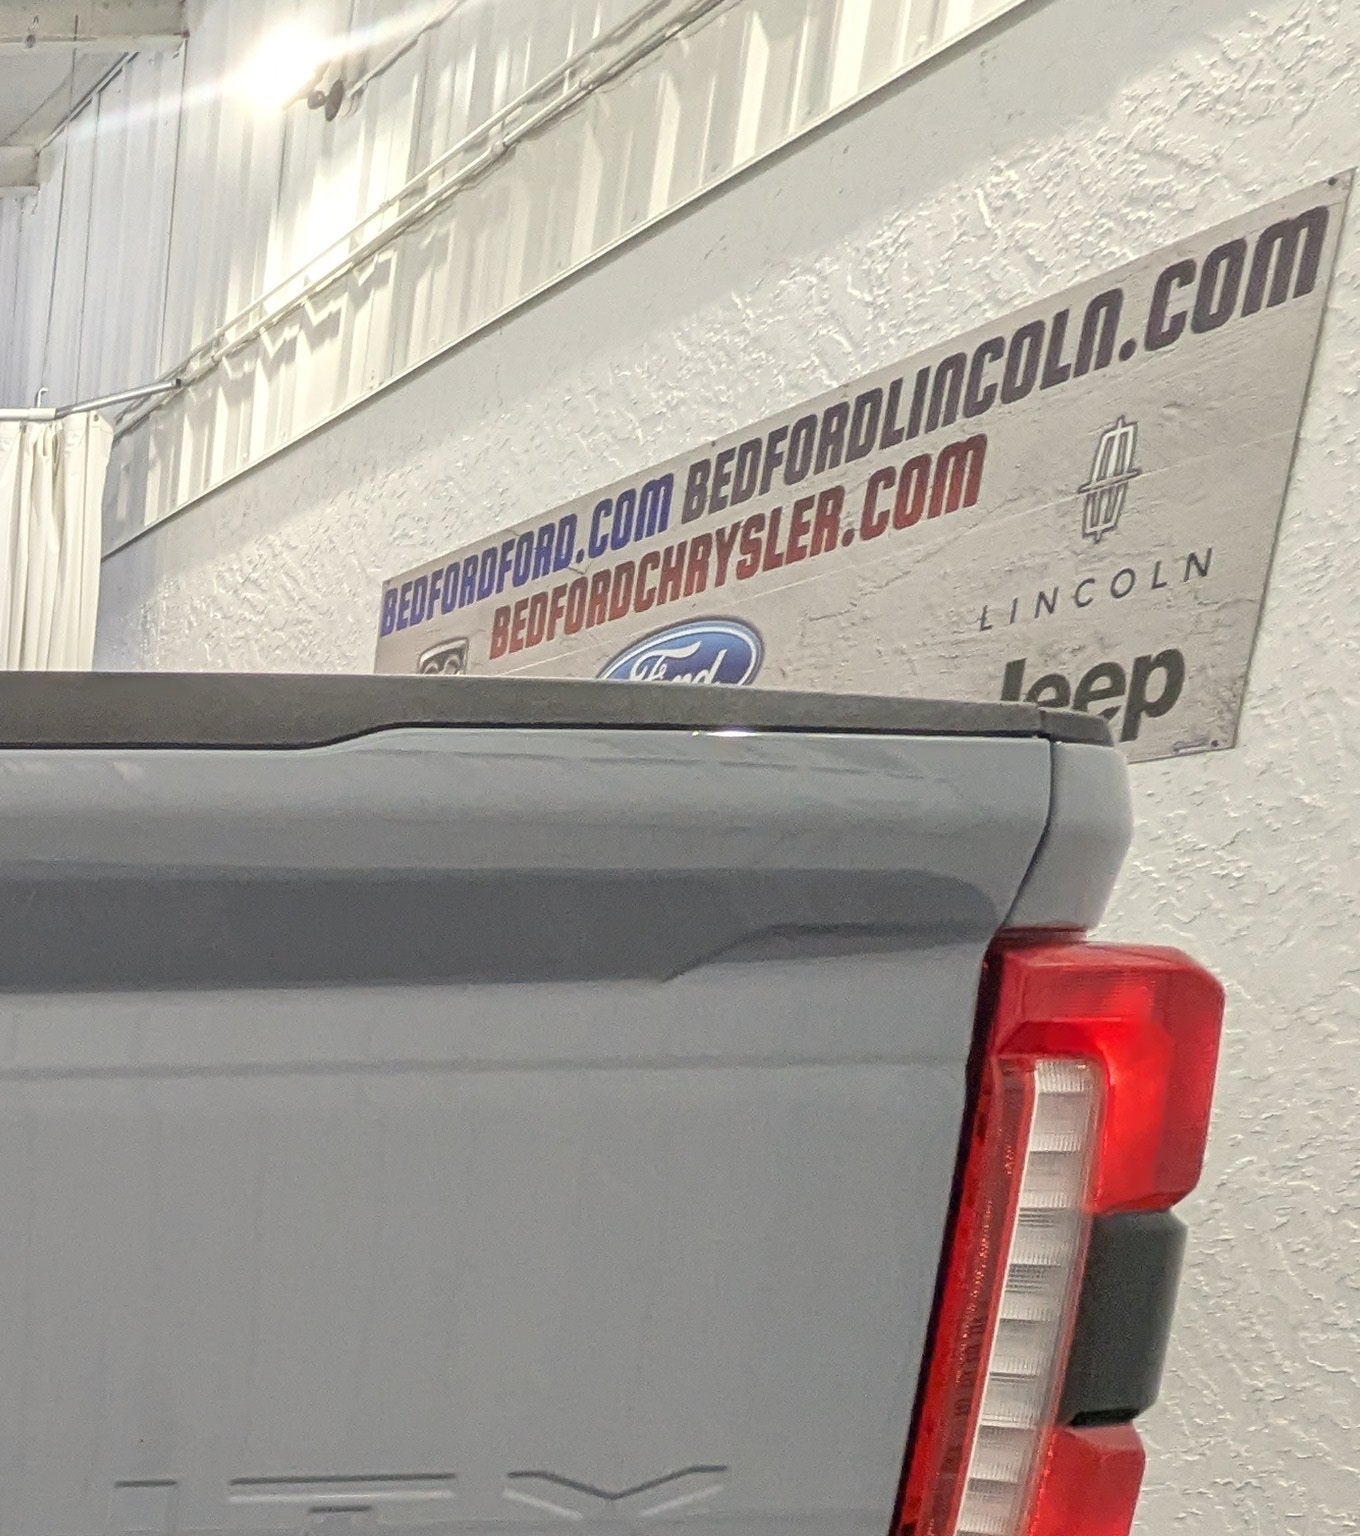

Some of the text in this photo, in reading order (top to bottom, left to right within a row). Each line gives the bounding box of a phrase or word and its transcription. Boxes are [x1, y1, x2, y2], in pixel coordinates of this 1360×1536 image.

[380, 205, 1329, 637] BEDFORDFORD.COM BEDFORDLINCOLN.COM
[489, 433, 987, 660] BEDFORDCHRYSLER.COM
[979, 547, 1212, 632] LINCOLN
[630, 641, 727, 685] Fd
